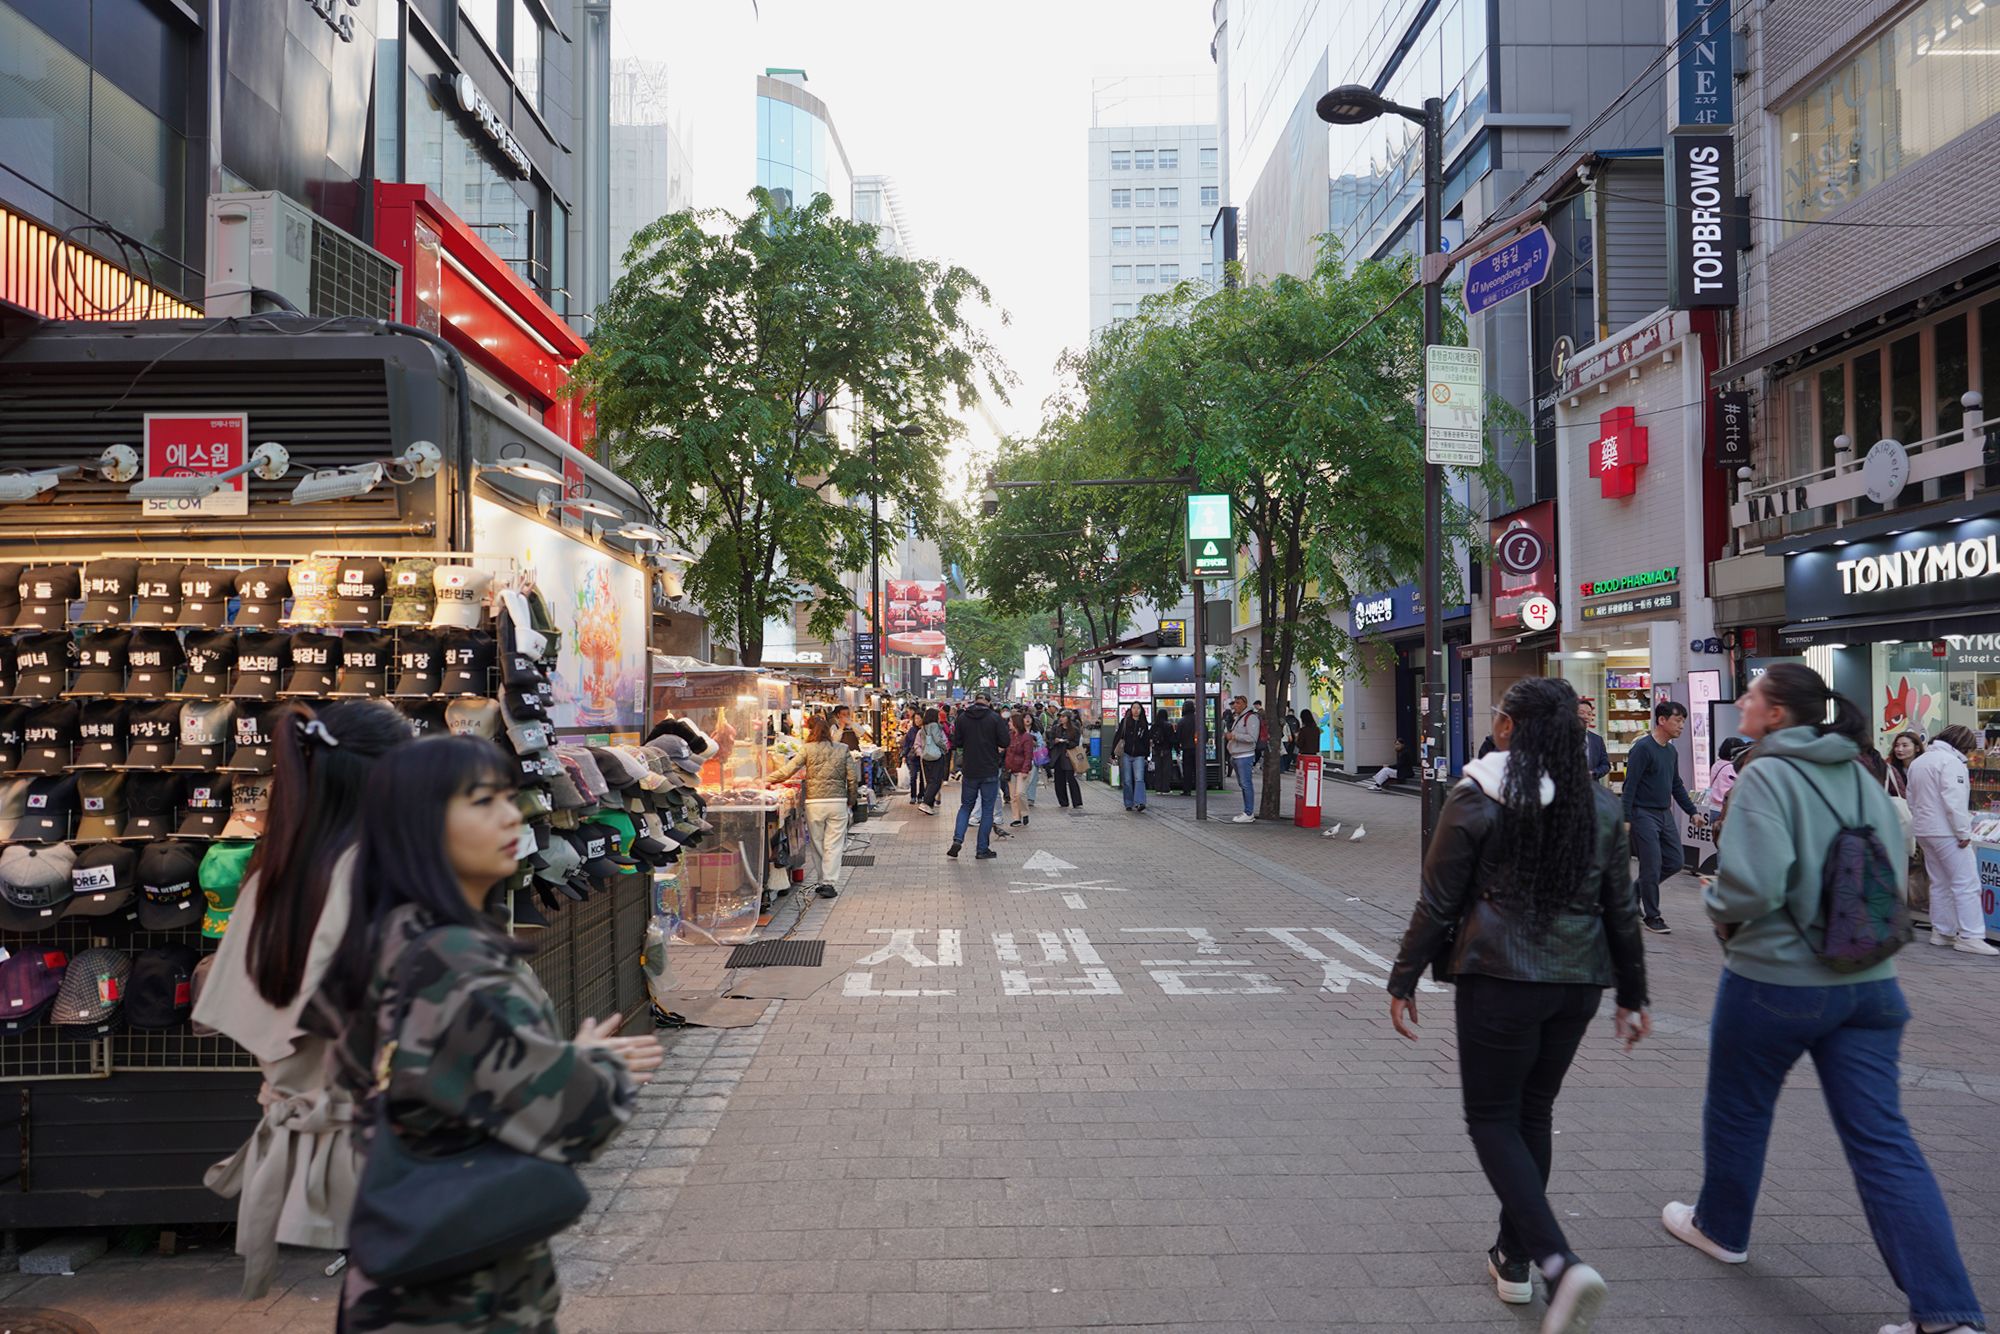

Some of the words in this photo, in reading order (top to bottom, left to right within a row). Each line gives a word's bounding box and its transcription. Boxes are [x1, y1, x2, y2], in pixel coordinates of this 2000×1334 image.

[1693, 0, 1718, 95] INE
[1695, 110, 1718, 124] 4F
[1689, 145, 1724, 295] TOPBROWS
[1492, 244, 1518, 272] 명동길
[1471, 281, 1480, 294] 47
[1480, 258, 1533, 293] Myeongdong-gil
[1533, 248, 1542, 263] 51
[1724, 403, 1741, 452] #ette
[166, 443, 229, 468] 에스원
[1601, 436, 1618, 470] 藥
[149, 496, 201, 510] SECOM
[1748, 486, 1809, 522] HAIR
[1836, 534, 2000, 595] TONYMOL
[239, 581, 270, 599] 서울
[1593, 578, 1620, 594] GOOD
[1621, 567, 1677, 589] PHARMACY
[1530, 604, 1548, 624] 약
[79, 650, 112, 667] 오빠
[1709, 644, 1719, 653] 45
[189, 655, 207, 674] 왕
[1958, 655, 1989, 664] street
[1751, 668, 1767, 677] TO
[1120, 687, 1138, 696] SIM
[1687, 825, 1712, 841] SHEE
